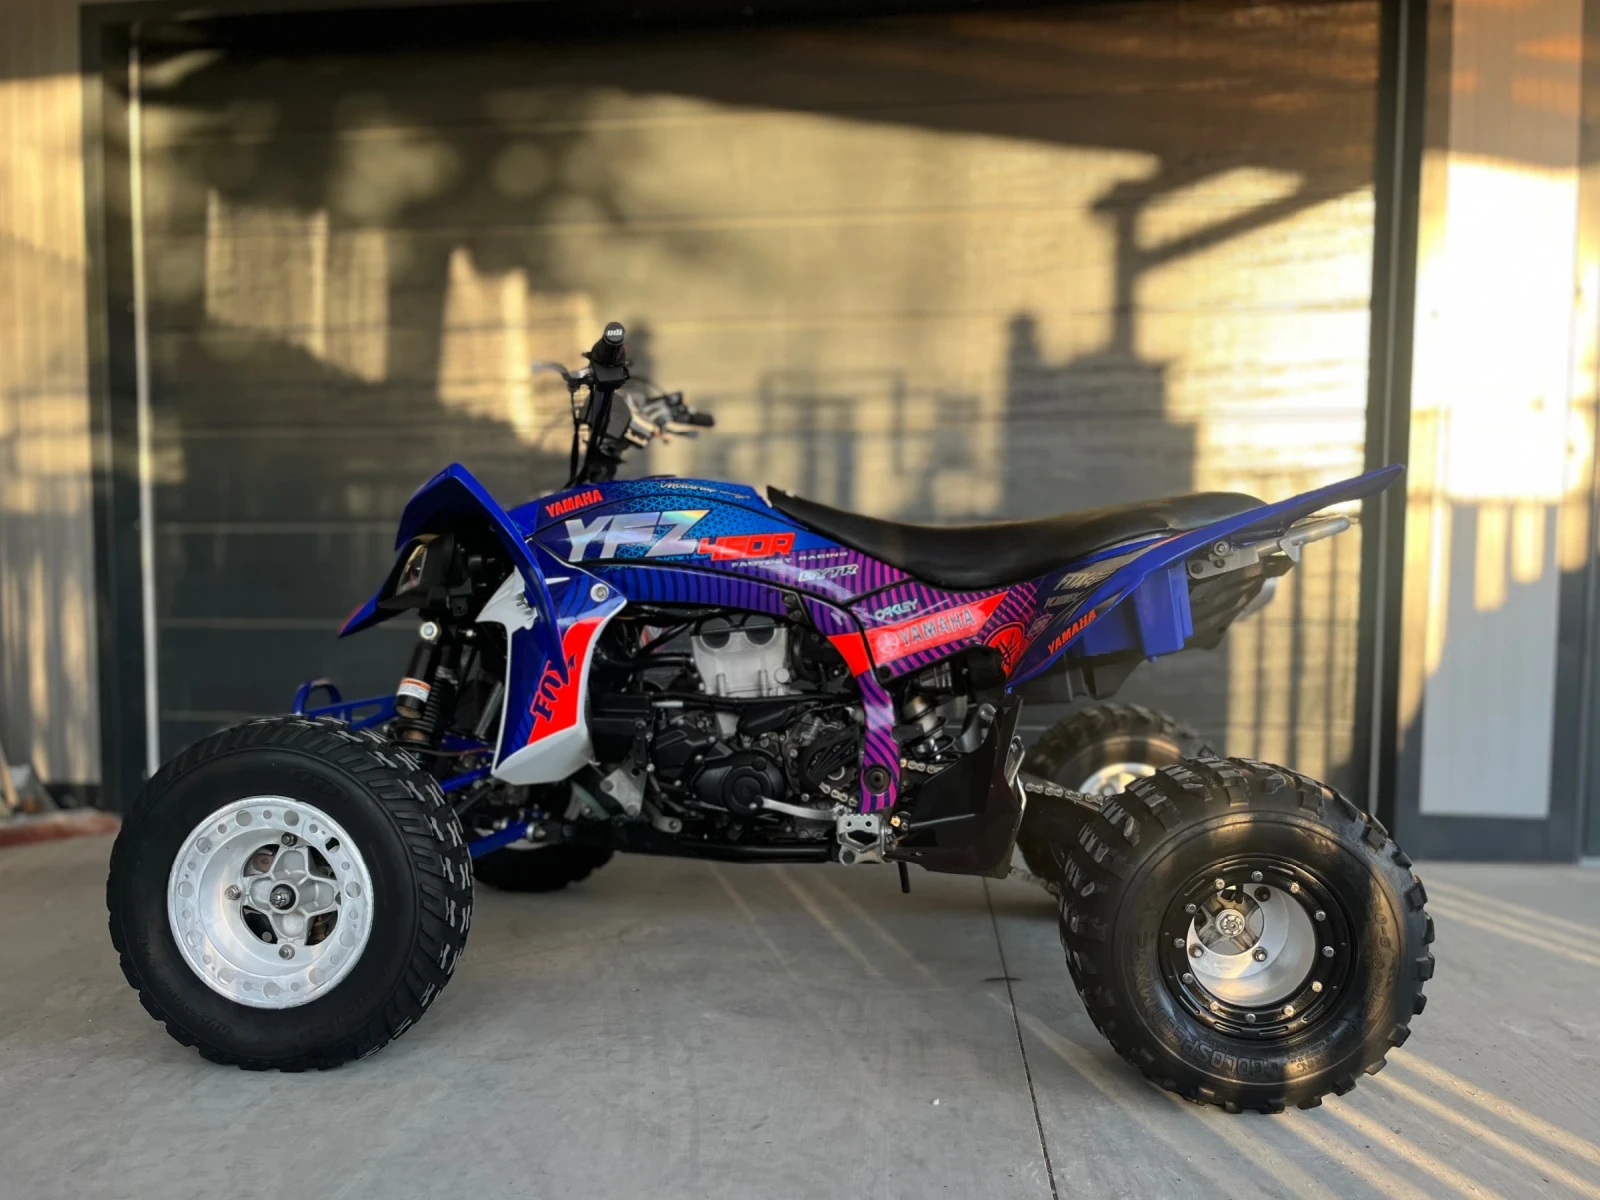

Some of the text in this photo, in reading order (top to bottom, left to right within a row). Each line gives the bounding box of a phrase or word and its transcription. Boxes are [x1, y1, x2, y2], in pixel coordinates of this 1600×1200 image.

[545, 489, 603, 518] YAMAHA
[565, 510, 795, 562] YFZ 450R
[798, 551, 849, 561] RACING
[874, 598, 918, 621] OAKLEY
[898, 609, 976, 646] YAMAHA
[1047, 609, 1097, 655] YAMAHA
[1145, 1006, 1264, 1075] GOLDSPEED
